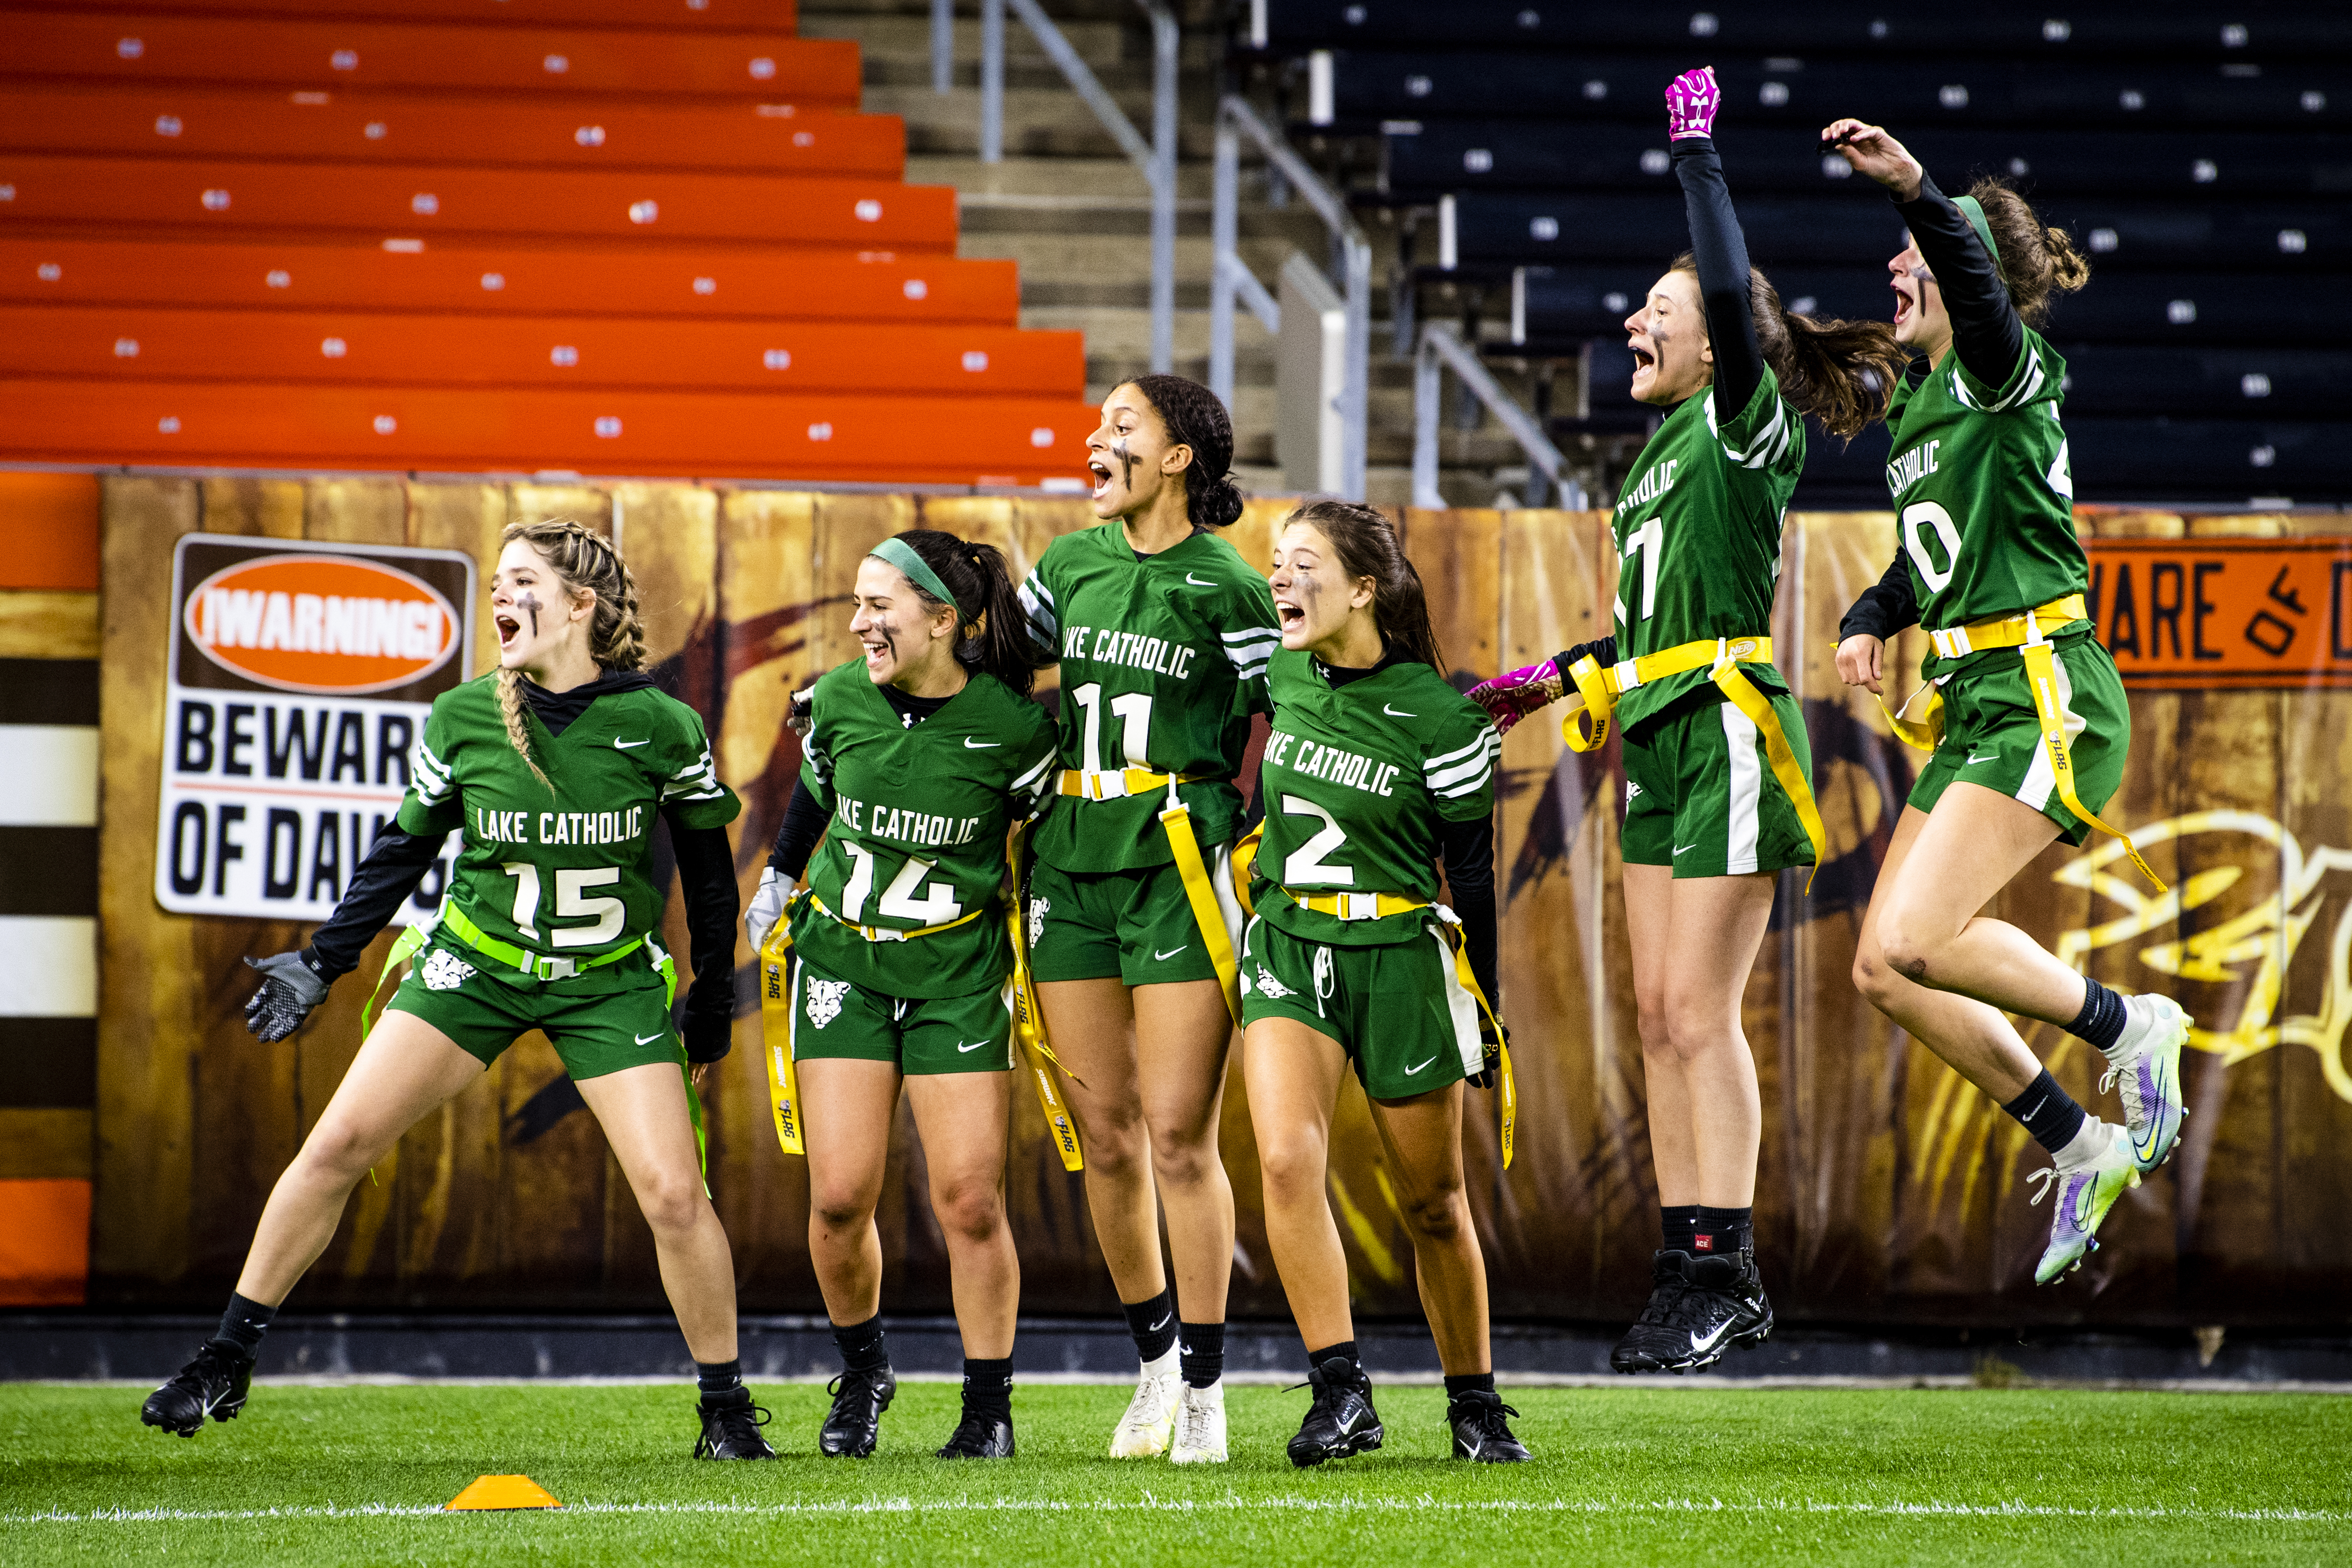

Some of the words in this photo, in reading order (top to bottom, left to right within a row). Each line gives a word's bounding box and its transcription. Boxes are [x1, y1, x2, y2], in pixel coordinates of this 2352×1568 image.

[2088, 561, 2224, 660] ARE
[2244, 563, 2309, 658] OF
[1092, 629, 1195, 680] CATHOLIC
[175, 700, 430, 787] BEWAR
[1072, 682, 1153, 773] 11
[1264, 729, 1295, 766] AKE
[1293, 740, 1400, 797] CATHOLIC
[477, 807, 528, 843] LAKE
[539, 805, 642, 845] CATHOLIC
[837, 792, 863, 831] AKE
[871, 805, 979, 845] CATHOLIC
[1282, 794, 1355, 886] 2
[171, 800, 246, 897] OF
[501, 861, 627, 948] 15
[840, 839, 964, 928] 14
[767, 969, 780, 999] FLAG
[1035, 1067, 1057, 1107] SUBWAY
[778, 1107, 795, 1138] FLAG
[1054, 1123, 1075, 1153] FLAG
[1696, 1240, 1708, 1248] ACE
[1744, 1297, 1761, 1314] ALPHA
